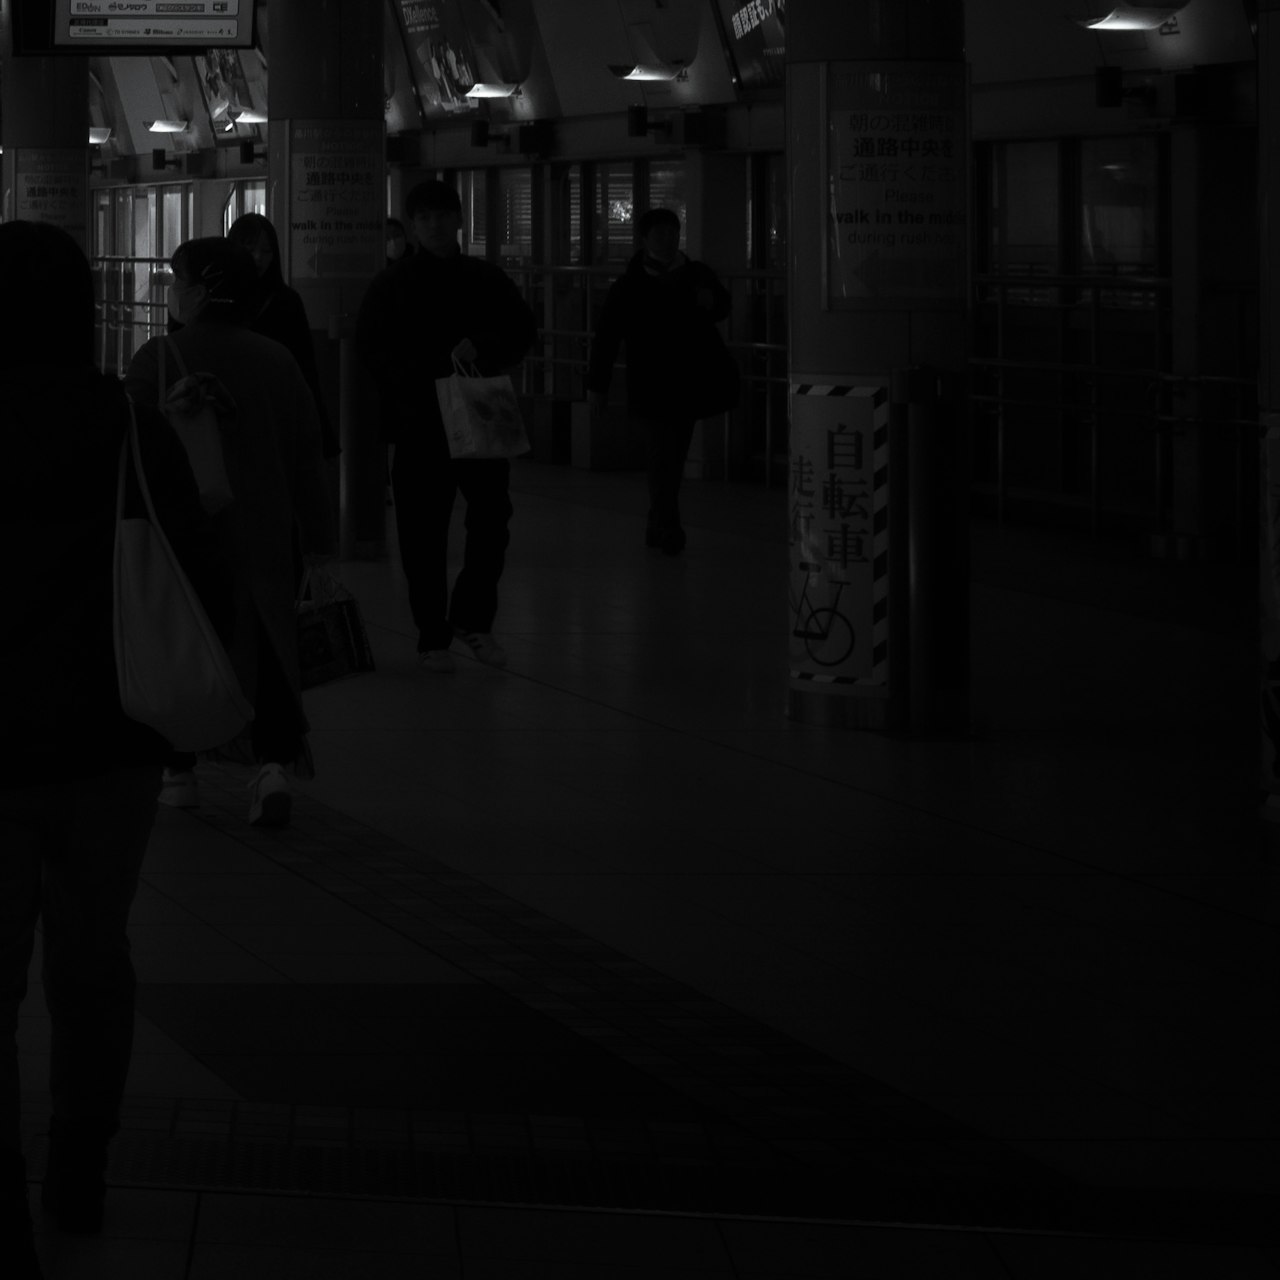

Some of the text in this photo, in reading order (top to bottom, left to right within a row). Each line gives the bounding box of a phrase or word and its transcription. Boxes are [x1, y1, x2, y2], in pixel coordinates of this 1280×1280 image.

[853, 137, 954, 157] 通路中央を
[306, 172, 374, 185] 通路中央を
[885, 189, 934, 203] Please
[876, 209, 891, 224] in
[898, 210, 925, 224] the
[291, 221, 317, 231] walk
[321, 221, 331, 231] in
[334, 221, 353, 231] the
[848, 232, 895, 247] during
[822, 423, 869, 570] 自転車
